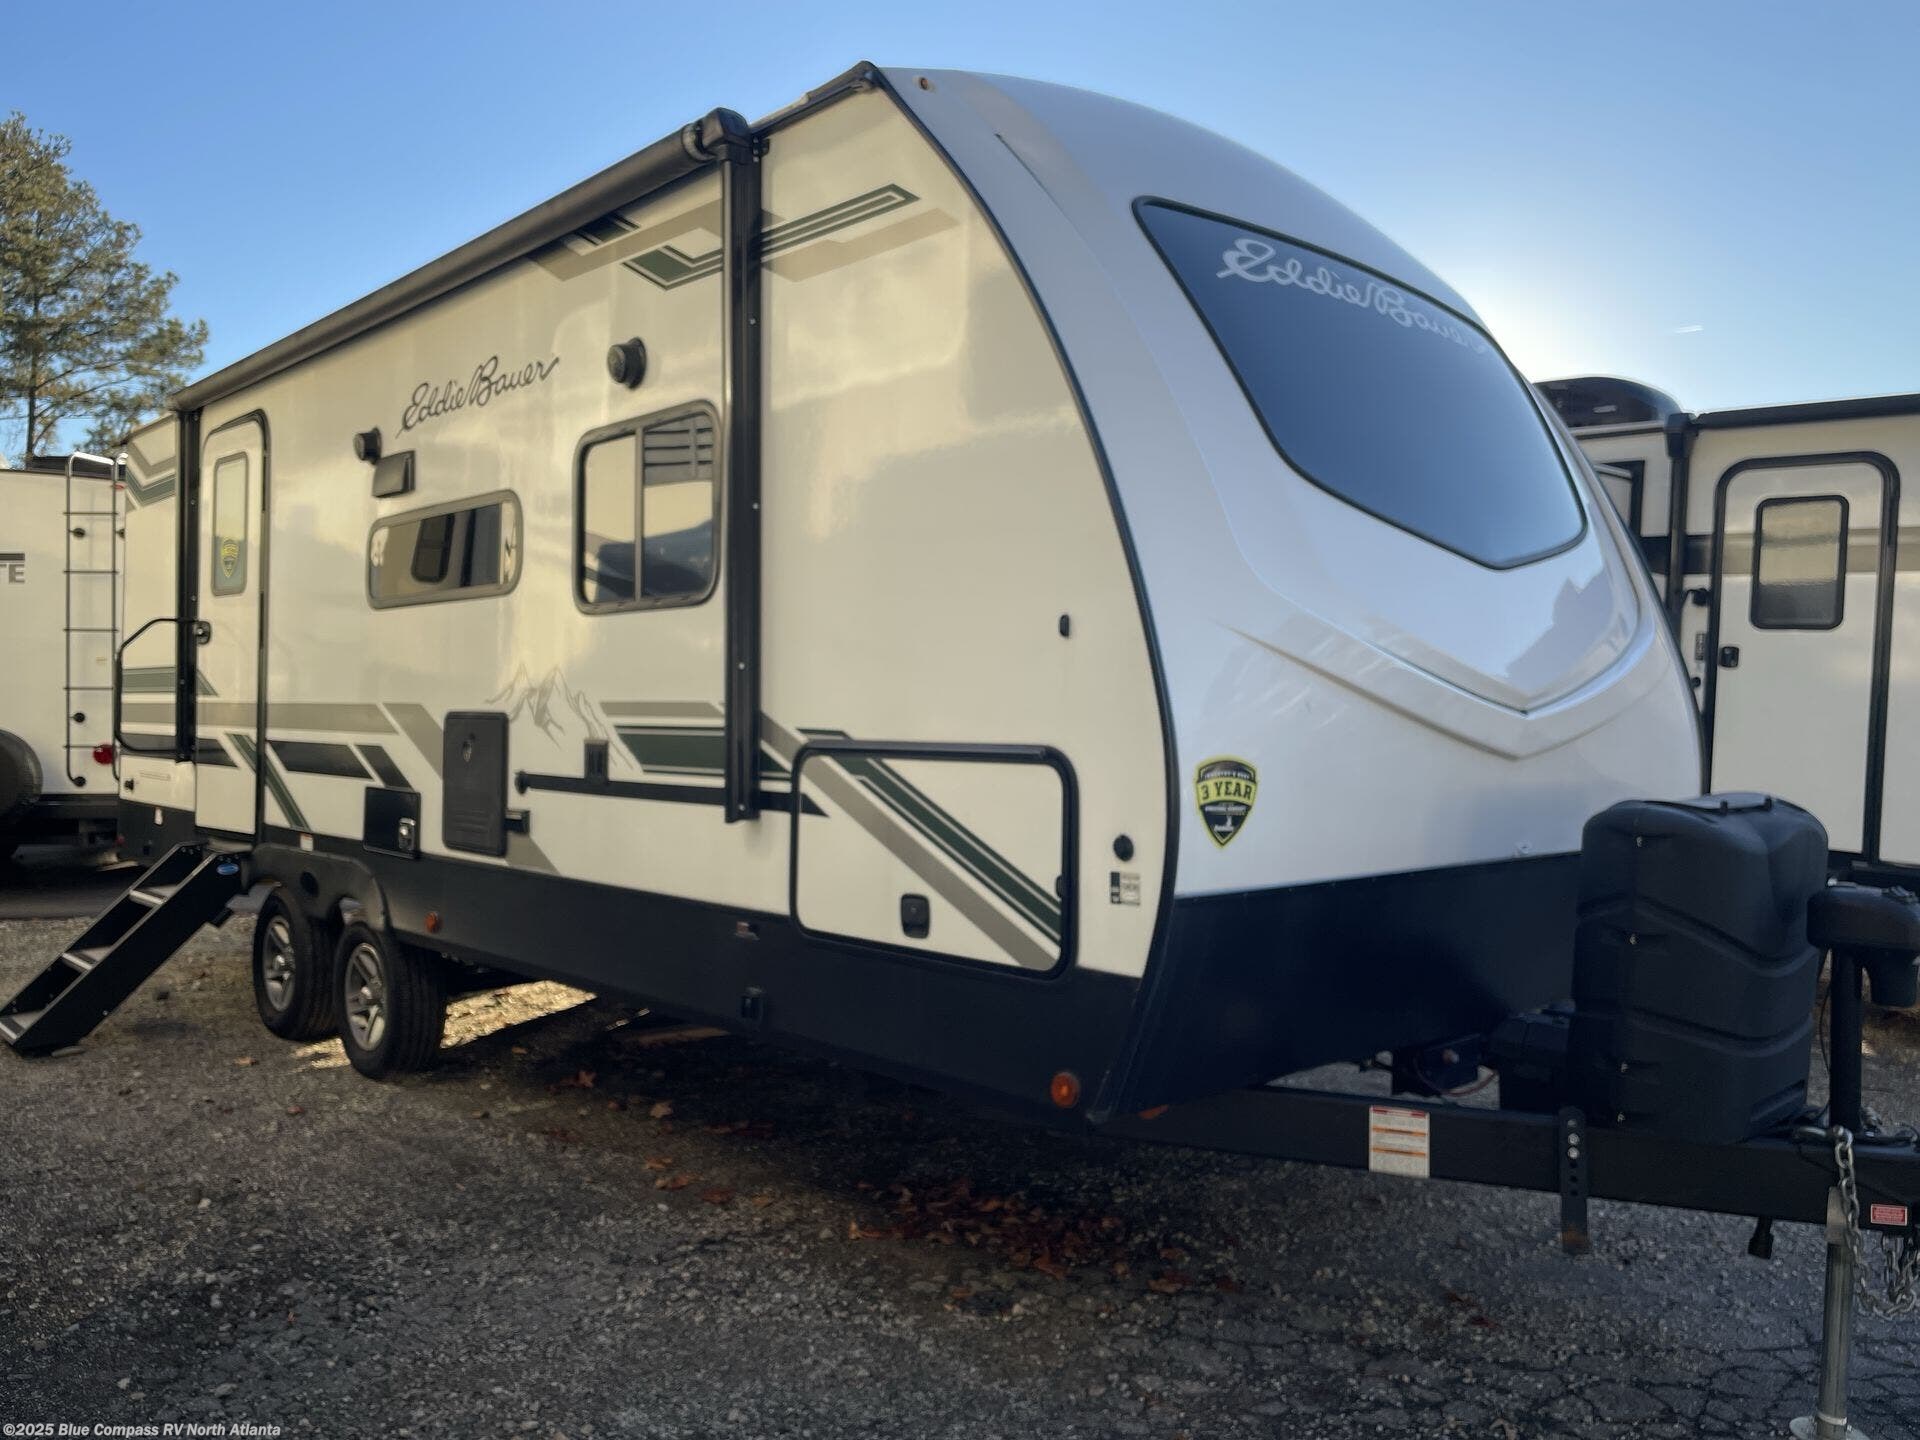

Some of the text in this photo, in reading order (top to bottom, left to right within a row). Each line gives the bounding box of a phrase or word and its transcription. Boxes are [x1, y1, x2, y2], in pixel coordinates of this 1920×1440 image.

[1216, 238, 1368, 306] Eddie
[395, 355, 560, 439] Eddie Bauer
[1200, 781, 1253, 801] 3 YEAR
